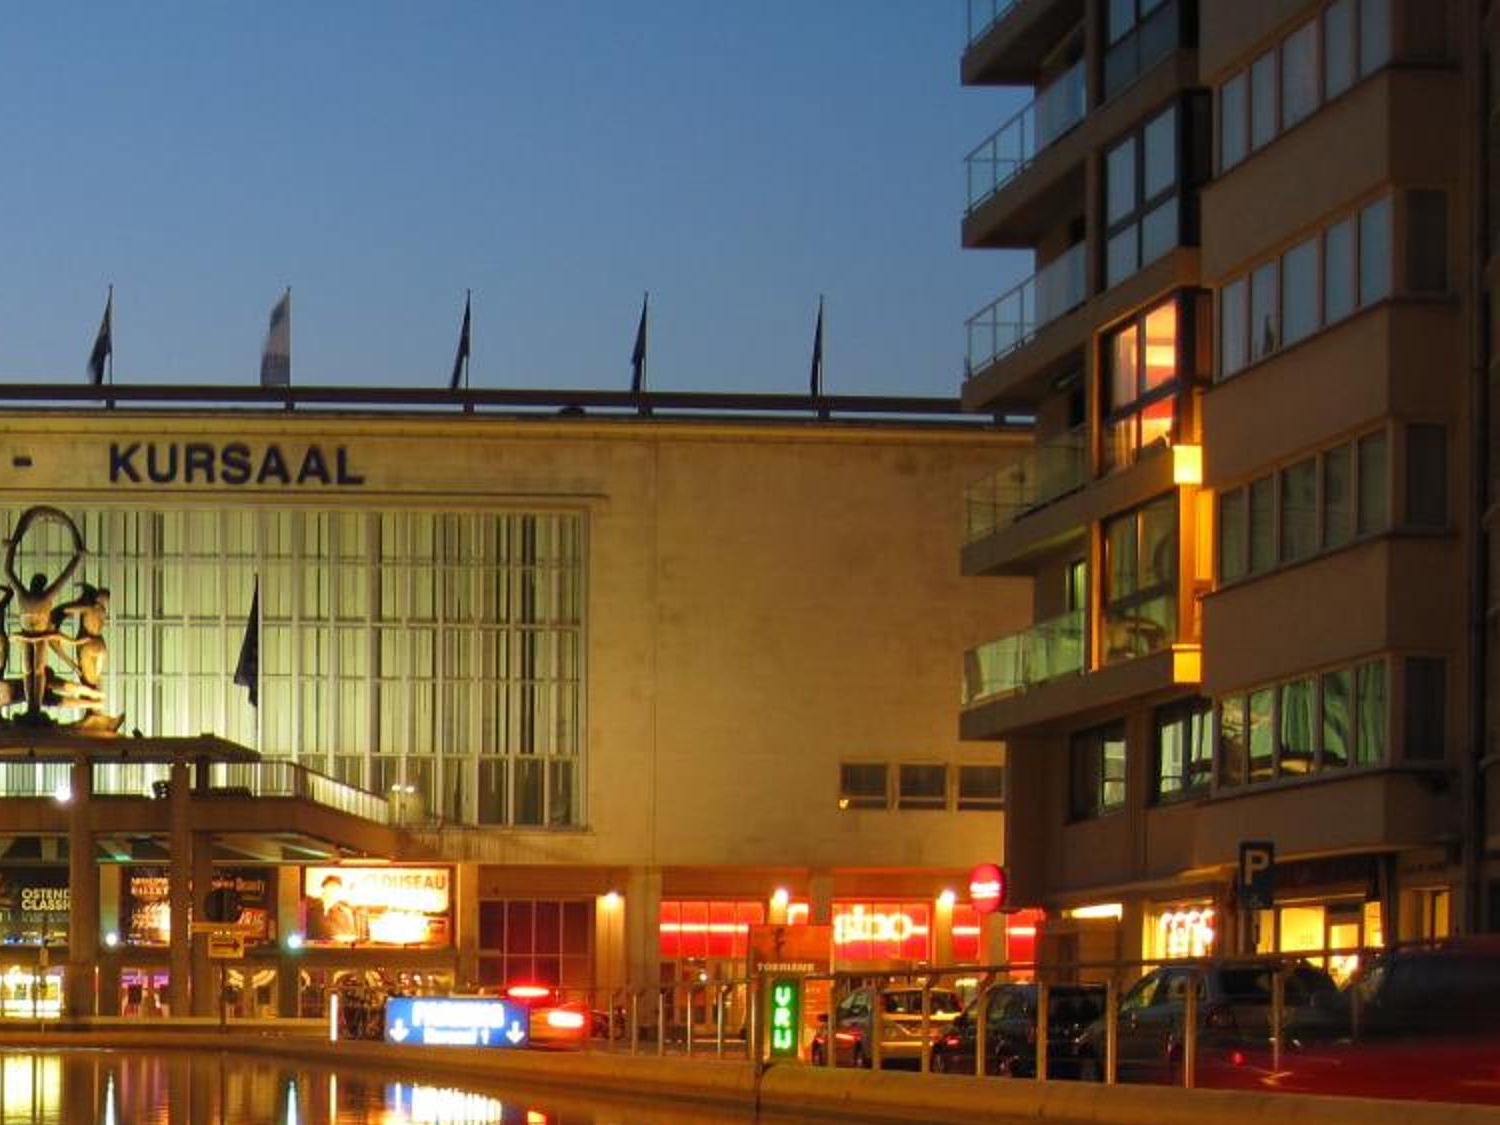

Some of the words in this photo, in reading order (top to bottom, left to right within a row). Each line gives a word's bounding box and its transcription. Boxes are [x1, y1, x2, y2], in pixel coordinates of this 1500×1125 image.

[108, 440, 366, 485] KURSAAL
[1244, 849, 1269, 886] P
[364, 874, 446, 890] OUSEAU
[21, 899, 69, 911] CLASSI
